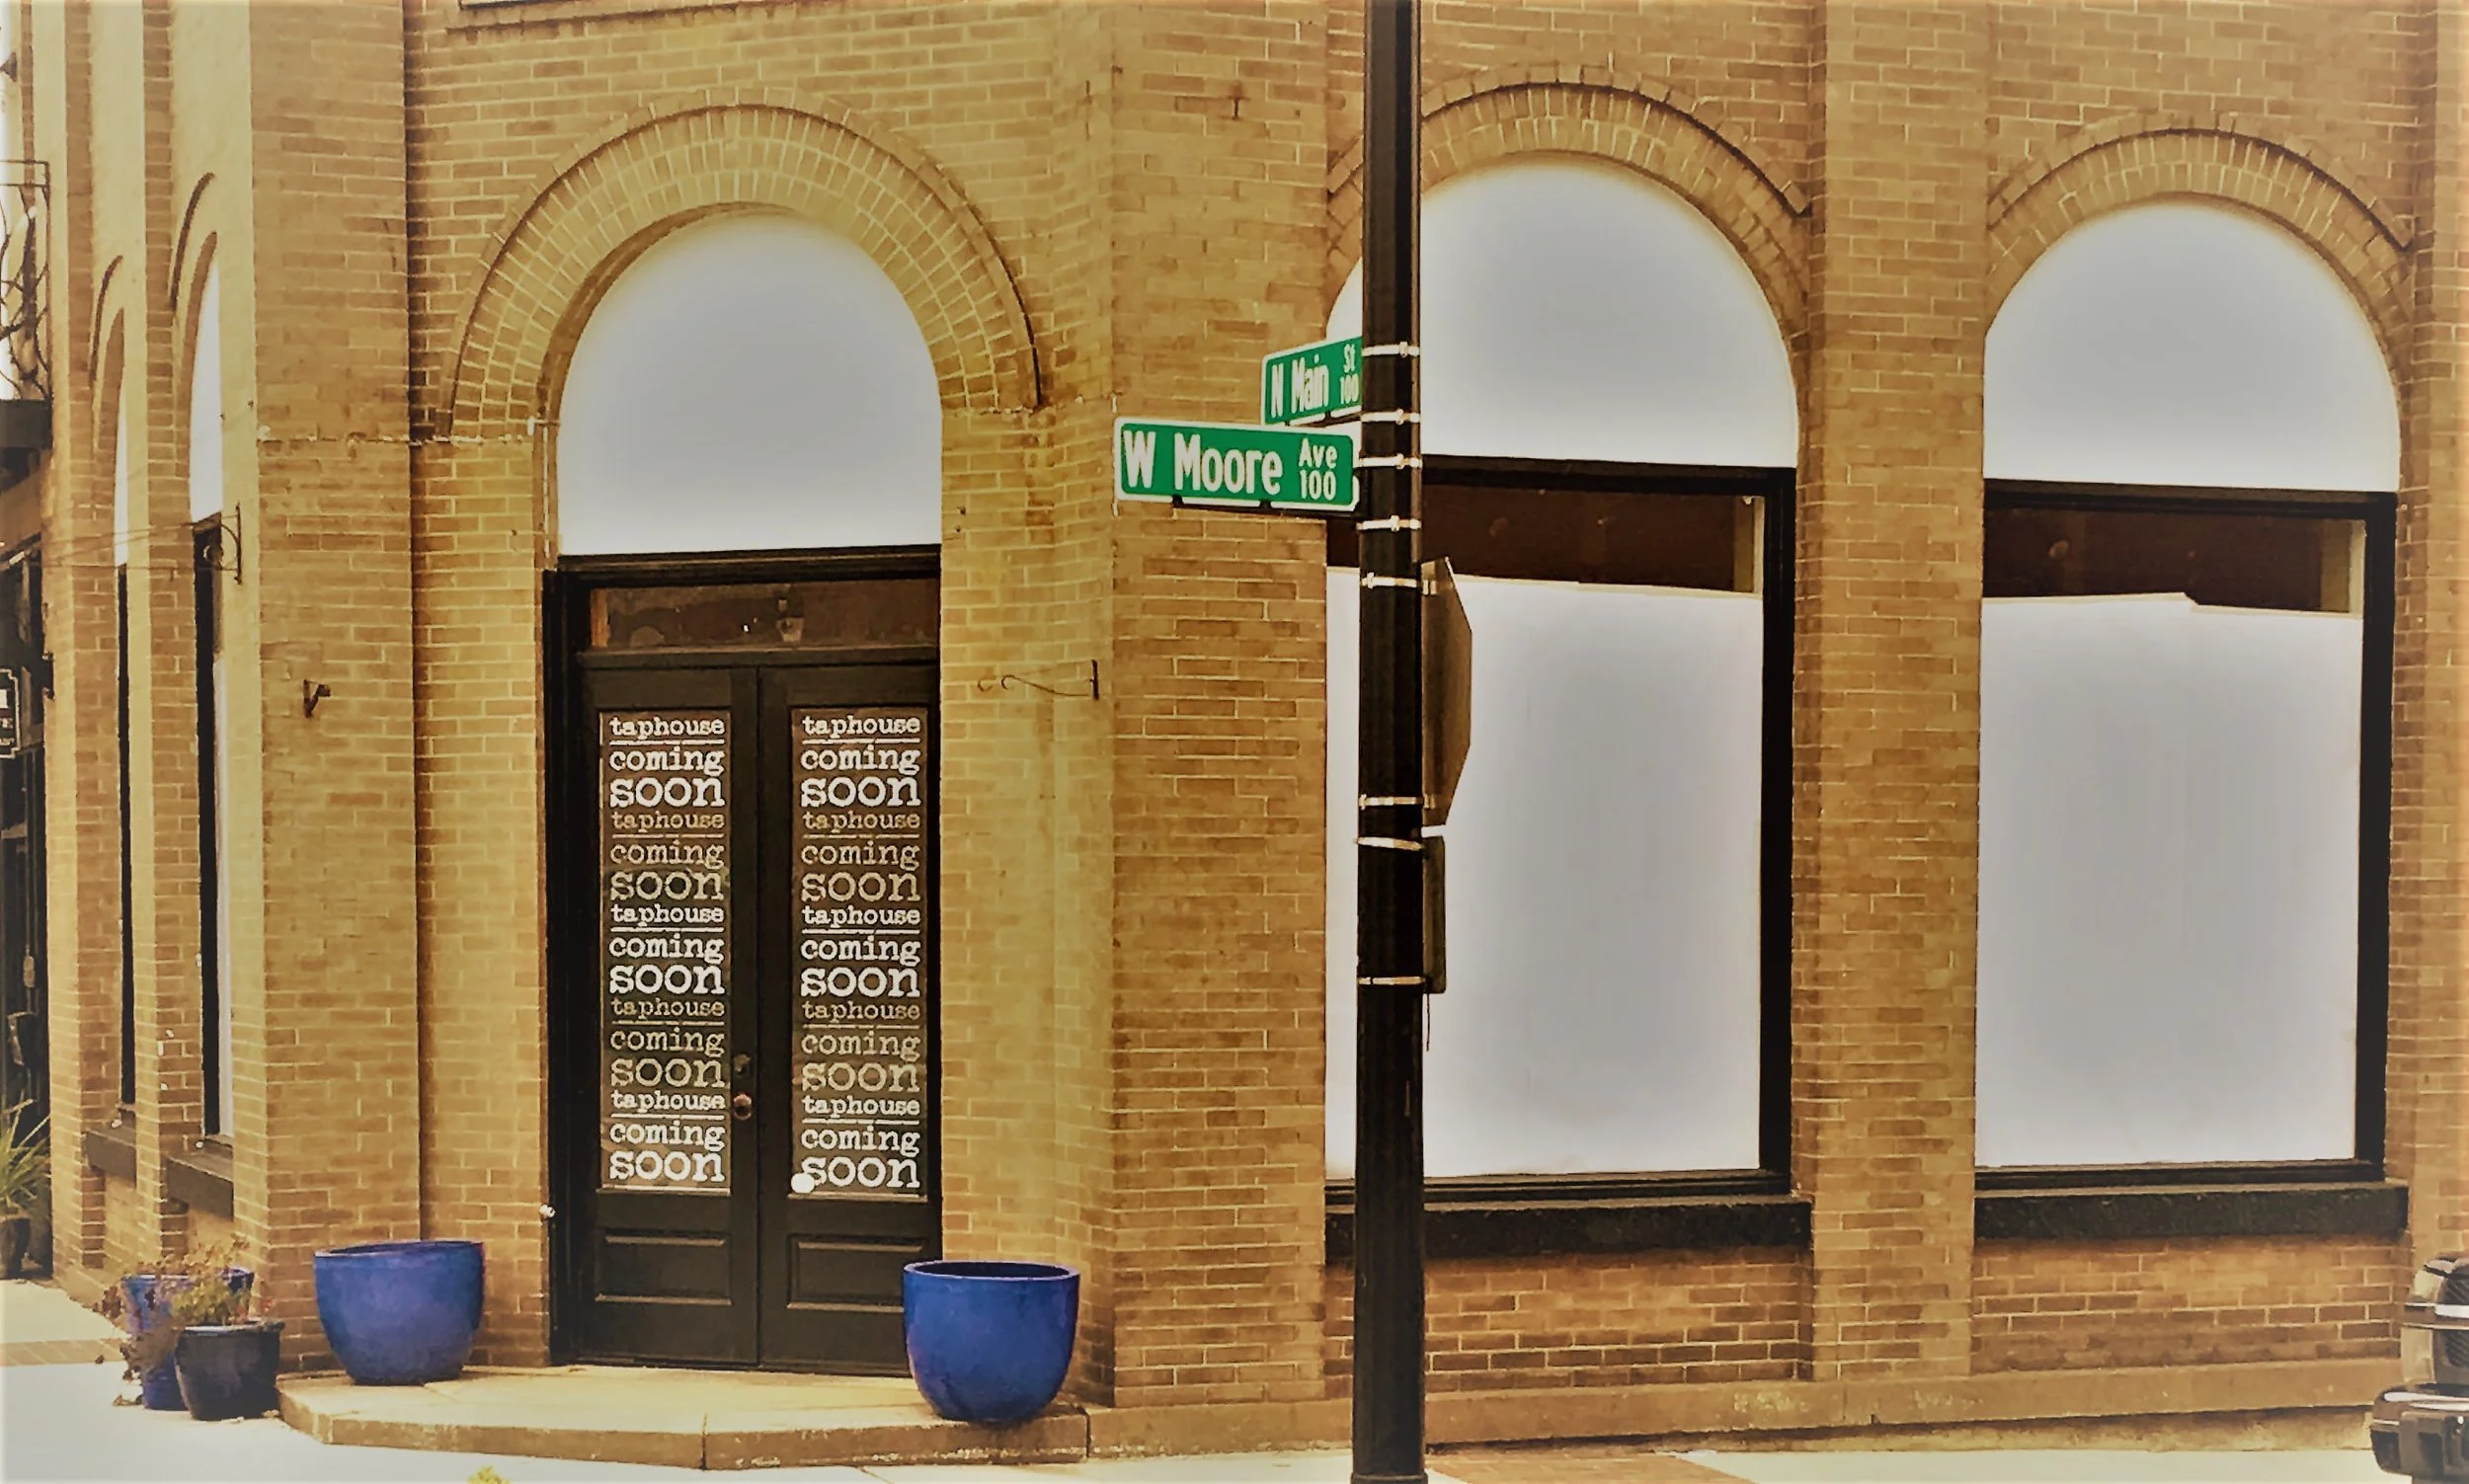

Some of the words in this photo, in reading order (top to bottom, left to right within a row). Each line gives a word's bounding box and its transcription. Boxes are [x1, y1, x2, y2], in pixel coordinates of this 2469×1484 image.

[1343, 344, 1355, 373] St
[1271, 363, 1284, 417] N
[1292, 354, 1329, 413] Main
[1340, 375, 1359, 404] 100
[1123, 430, 1155, 489] W
[1174, 432, 1283, 494] Moore
[1299, 437, 1337, 468] Ave
[1300, 470, 1336, 500] 100
[609, 717, 725, 740] taphouse
[801, 715, 920, 737] taphouse
[609, 744, 725, 774] coming
[801, 744, 920, 773] coming
[609, 776, 725, 808] soon
[801, 776, 920, 808] soon
[611, 811, 725, 833] taphouse
[803, 811, 920, 832] taphouse
[610, 837, 725, 869] coming
[801, 837, 920, 870] coming
[610, 871, 724, 902] soon
[801, 872, 920, 902] soon
[610, 905, 725, 927] taphouse
[801, 906, 920, 928] taphouse
[609, 931, 725, 964] coming
[801, 932, 920, 965] coming
[609, 965, 725, 995] soon
[801, 967, 920, 997] soon
[611, 998, 725, 1020] taphouse
[802, 1000, 919, 1023] taphouse
[610, 1026, 725, 1056] coming
[801, 1028, 920, 1059] coming
[610, 1057, 724, 1088] soon
[801, 1061, 920, 1093] soon
[611, 1090, 725, 1113] taphouse
[803, 1095, 920, 1117] taphouse
[609, 1119, 725, 1149] coming
[801, 1123, 920, 1155] coming
[609, 1150, 725, 1182] soon
[801, 1157, 920, 1189] soon
